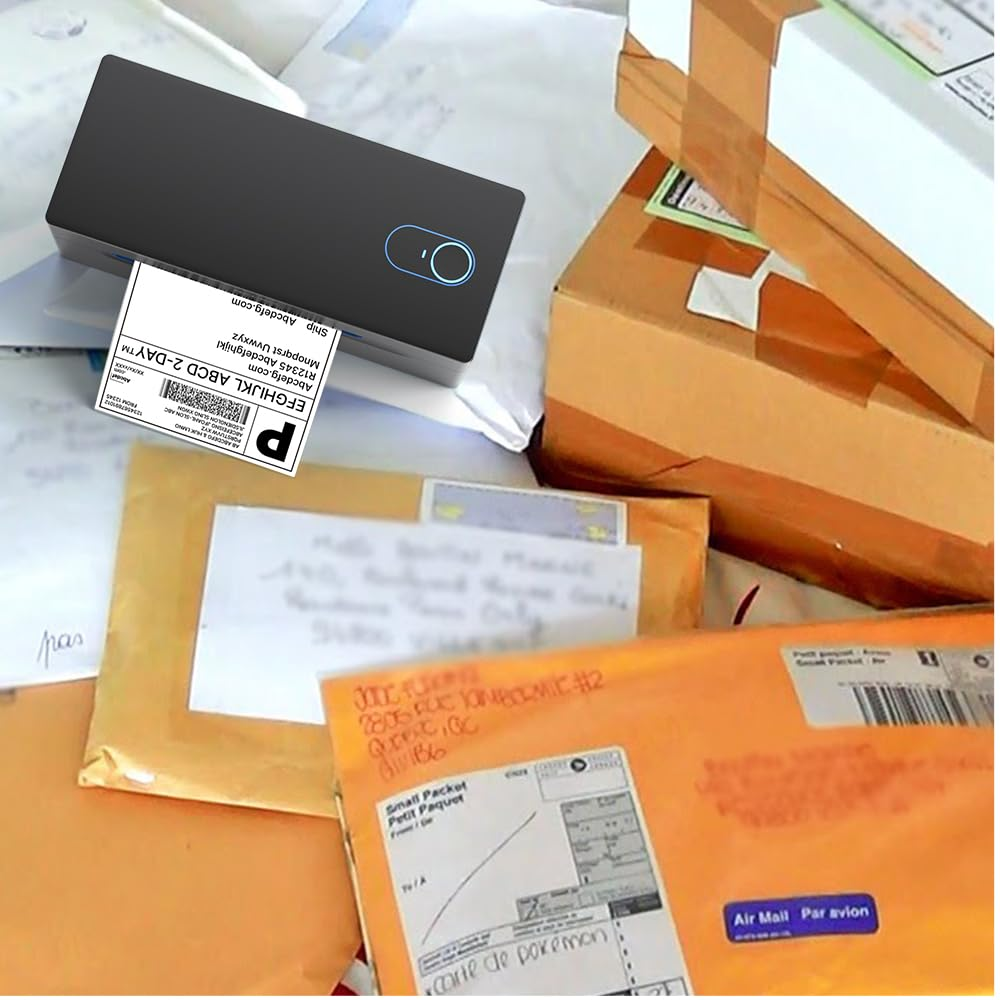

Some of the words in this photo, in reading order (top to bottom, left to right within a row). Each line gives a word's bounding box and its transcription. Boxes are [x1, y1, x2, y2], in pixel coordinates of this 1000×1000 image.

[232, 298, 296, 326] Abcdefg.com
[232, 333, 270, 352] Uvwxyz
[307, 323, 328, 337] Ship
[217, 341, 277, 367] Abcdefghijkl
[273, 347, 320, 369] Mnopqrst
[187, 363, 230, 385] ABCD
[248, 364, 312, 391] Abcdefg.com
[279, 362, 316, 380] R12345
[235, 378, 306, 412] EFGHIJKL
[256, 422, 296, 462] P
[385, 794, 421, 814] Small
[422, 781, 468, 802] Packet
[388, 809, 416, 827] Petit
[418, 794, 465, 818] Paquet
[734, 912, 756, 927] Air
[758, 909, 790, 925] Mail
[801, 906, 825, 921] Par
[829, 905, 870, 920] avion
